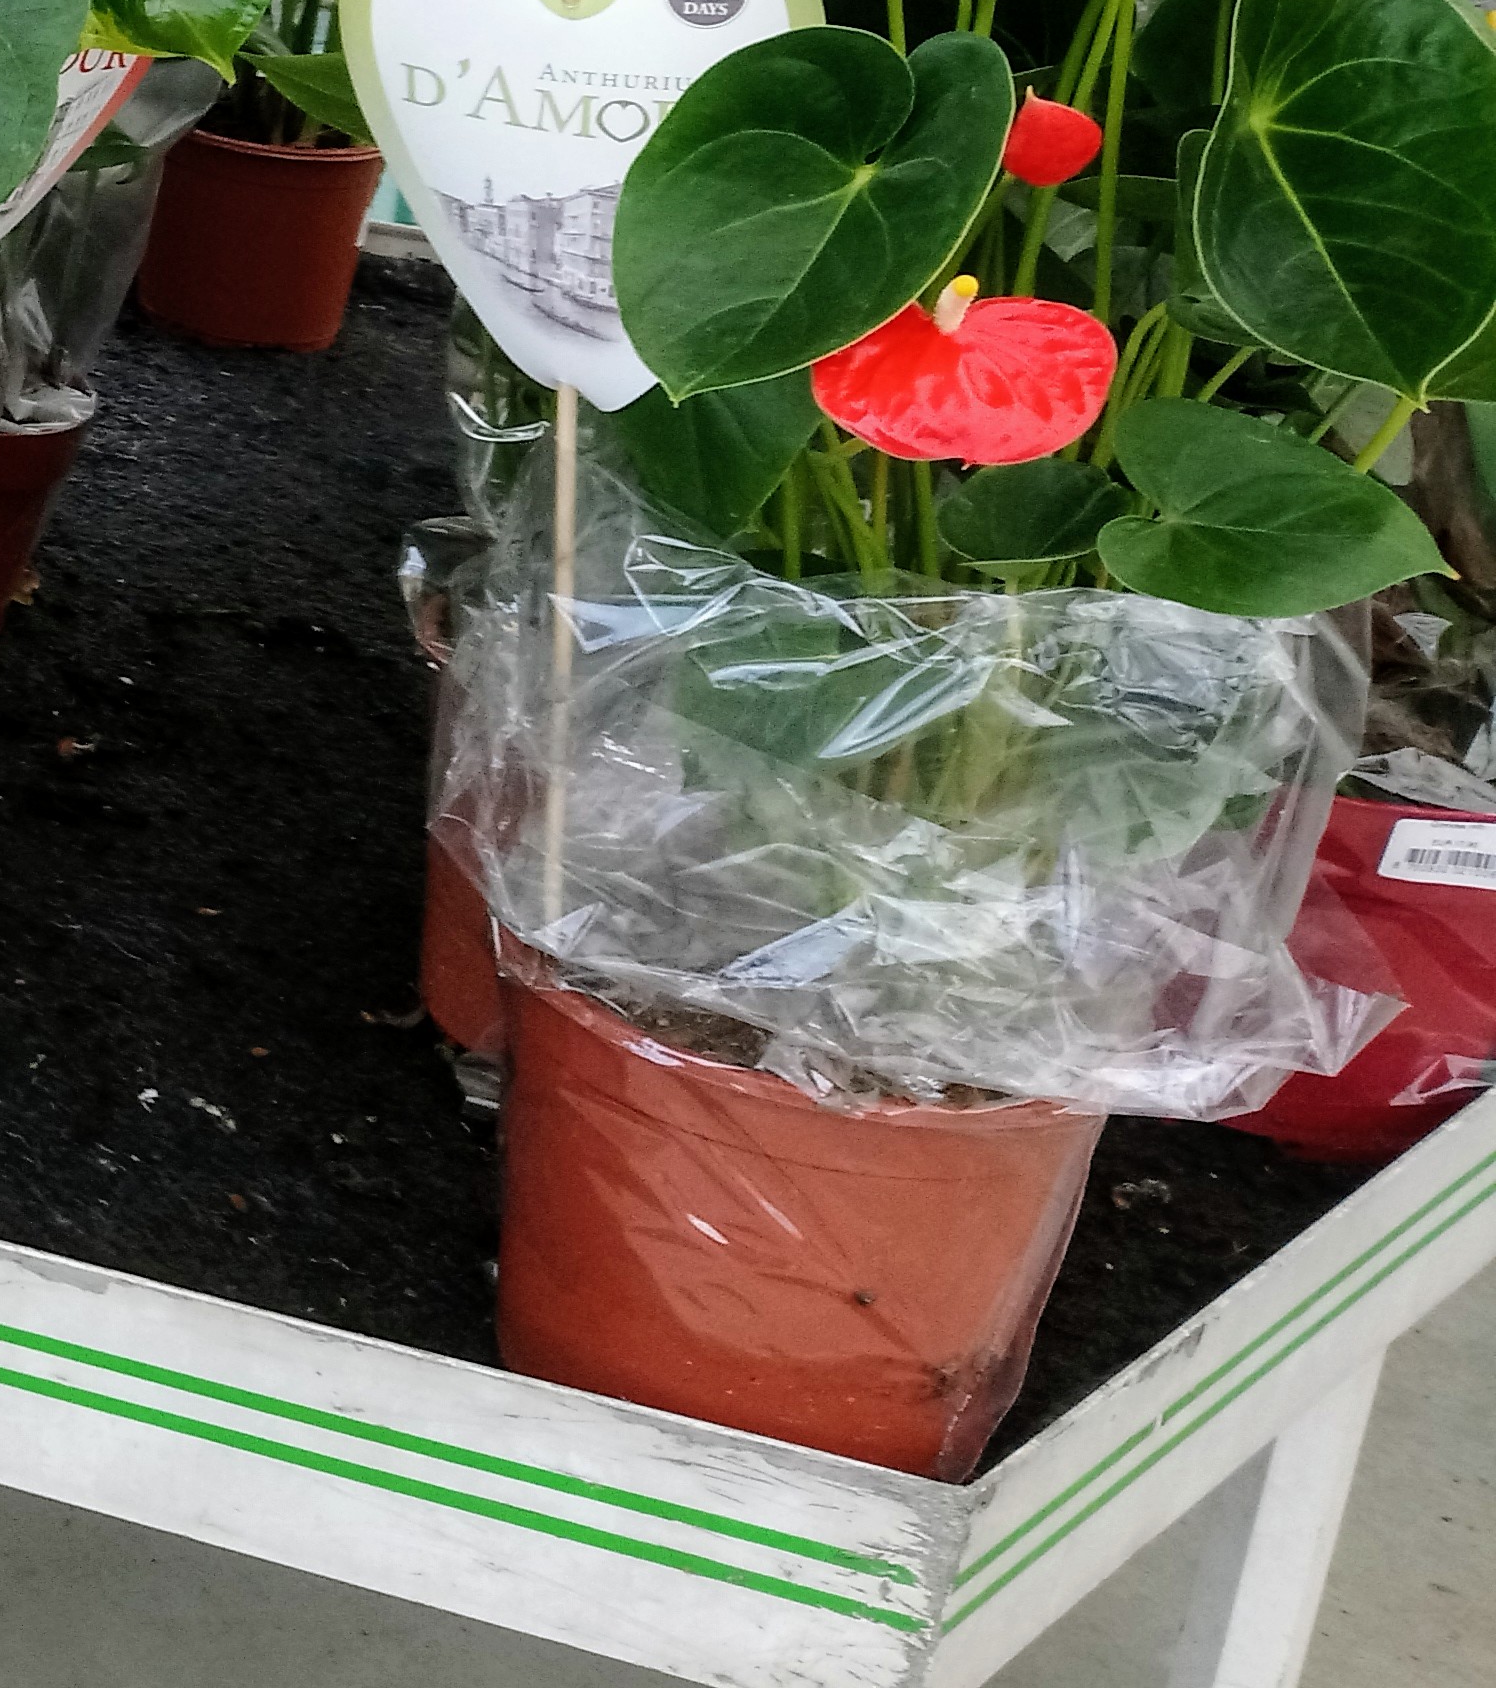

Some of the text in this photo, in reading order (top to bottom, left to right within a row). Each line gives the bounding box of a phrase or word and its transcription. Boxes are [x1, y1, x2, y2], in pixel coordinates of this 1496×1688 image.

[683, 1, 729, 16] DAYS
[537, 62, 692, 92] ANTHURIU
[400, 57, 677, 143] D'AMO
